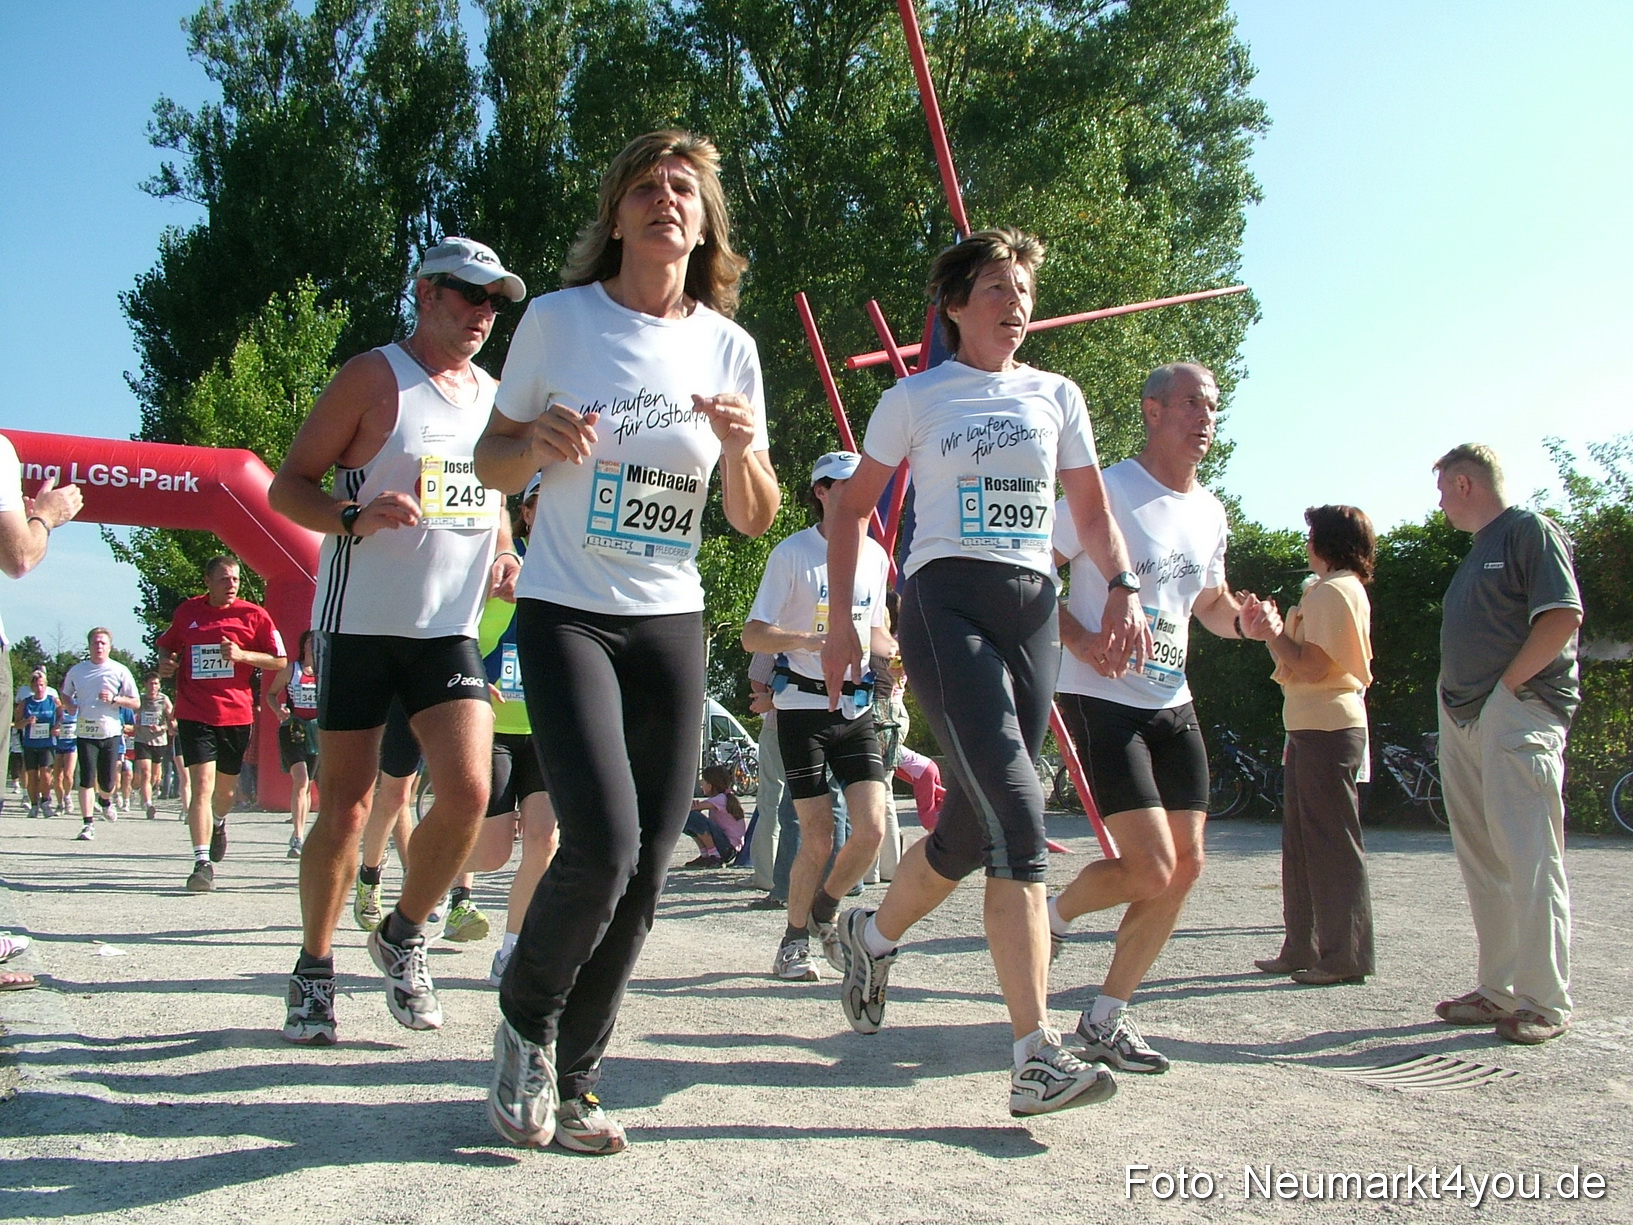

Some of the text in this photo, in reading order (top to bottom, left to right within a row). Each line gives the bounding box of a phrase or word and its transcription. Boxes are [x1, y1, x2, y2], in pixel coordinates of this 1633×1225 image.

[613, 414, 643, 445] für
[941, 431, 962, 457] Wir
[971, 425, 1052, 465] für Ostbay
[70, 462, 200, 493] LGS-Park
[427, 480, 436, 492] D
[626, 464, 698, 494] Michaela
[599, 488, 613, 504] C
[965, 498, 977, 512] C
[622, 498, 694, 536] 2994
[988, 503, 1047, 529] 2997
[817, 624, 824, 632] D
[1156, 618, 1176, 635] Hans
[202, 658, 230, 670] 2717
[1148, 641, 1184, 668] 2996
[505, 665, 512, 674] C
